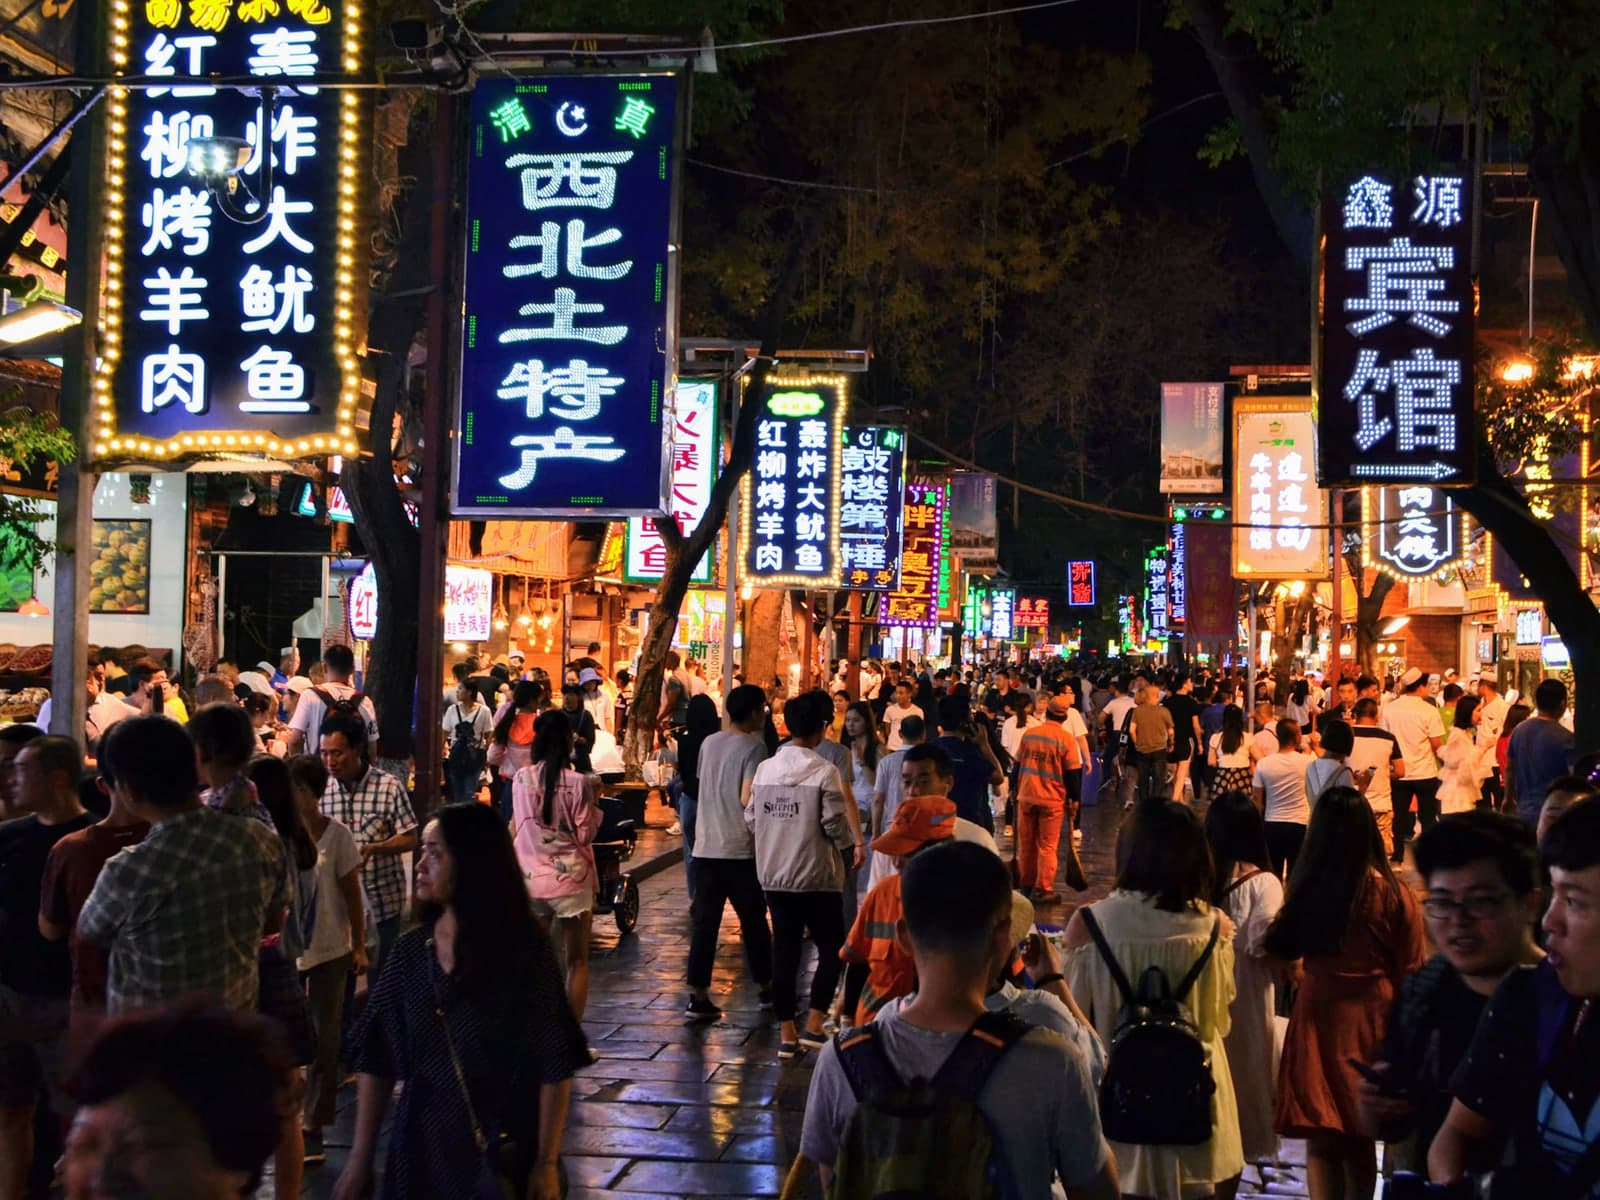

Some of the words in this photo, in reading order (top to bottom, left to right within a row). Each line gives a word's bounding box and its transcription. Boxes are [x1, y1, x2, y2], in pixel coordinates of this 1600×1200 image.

[490, 97, 532, 143] 清
[615, 96, 656, 140] 真
[140, 32, 217, 414] 红柳烤羊肉
[1343, 176, 1463, 228] 鑫源
[496, 151, 634, 490] 西北土特产
[1343, 237, 1461, 451] 宾馆
[756, 420, 787, 571] 红柳烤羊肉
[795, 420, 827, 572] 轰炸大鱿鱼
